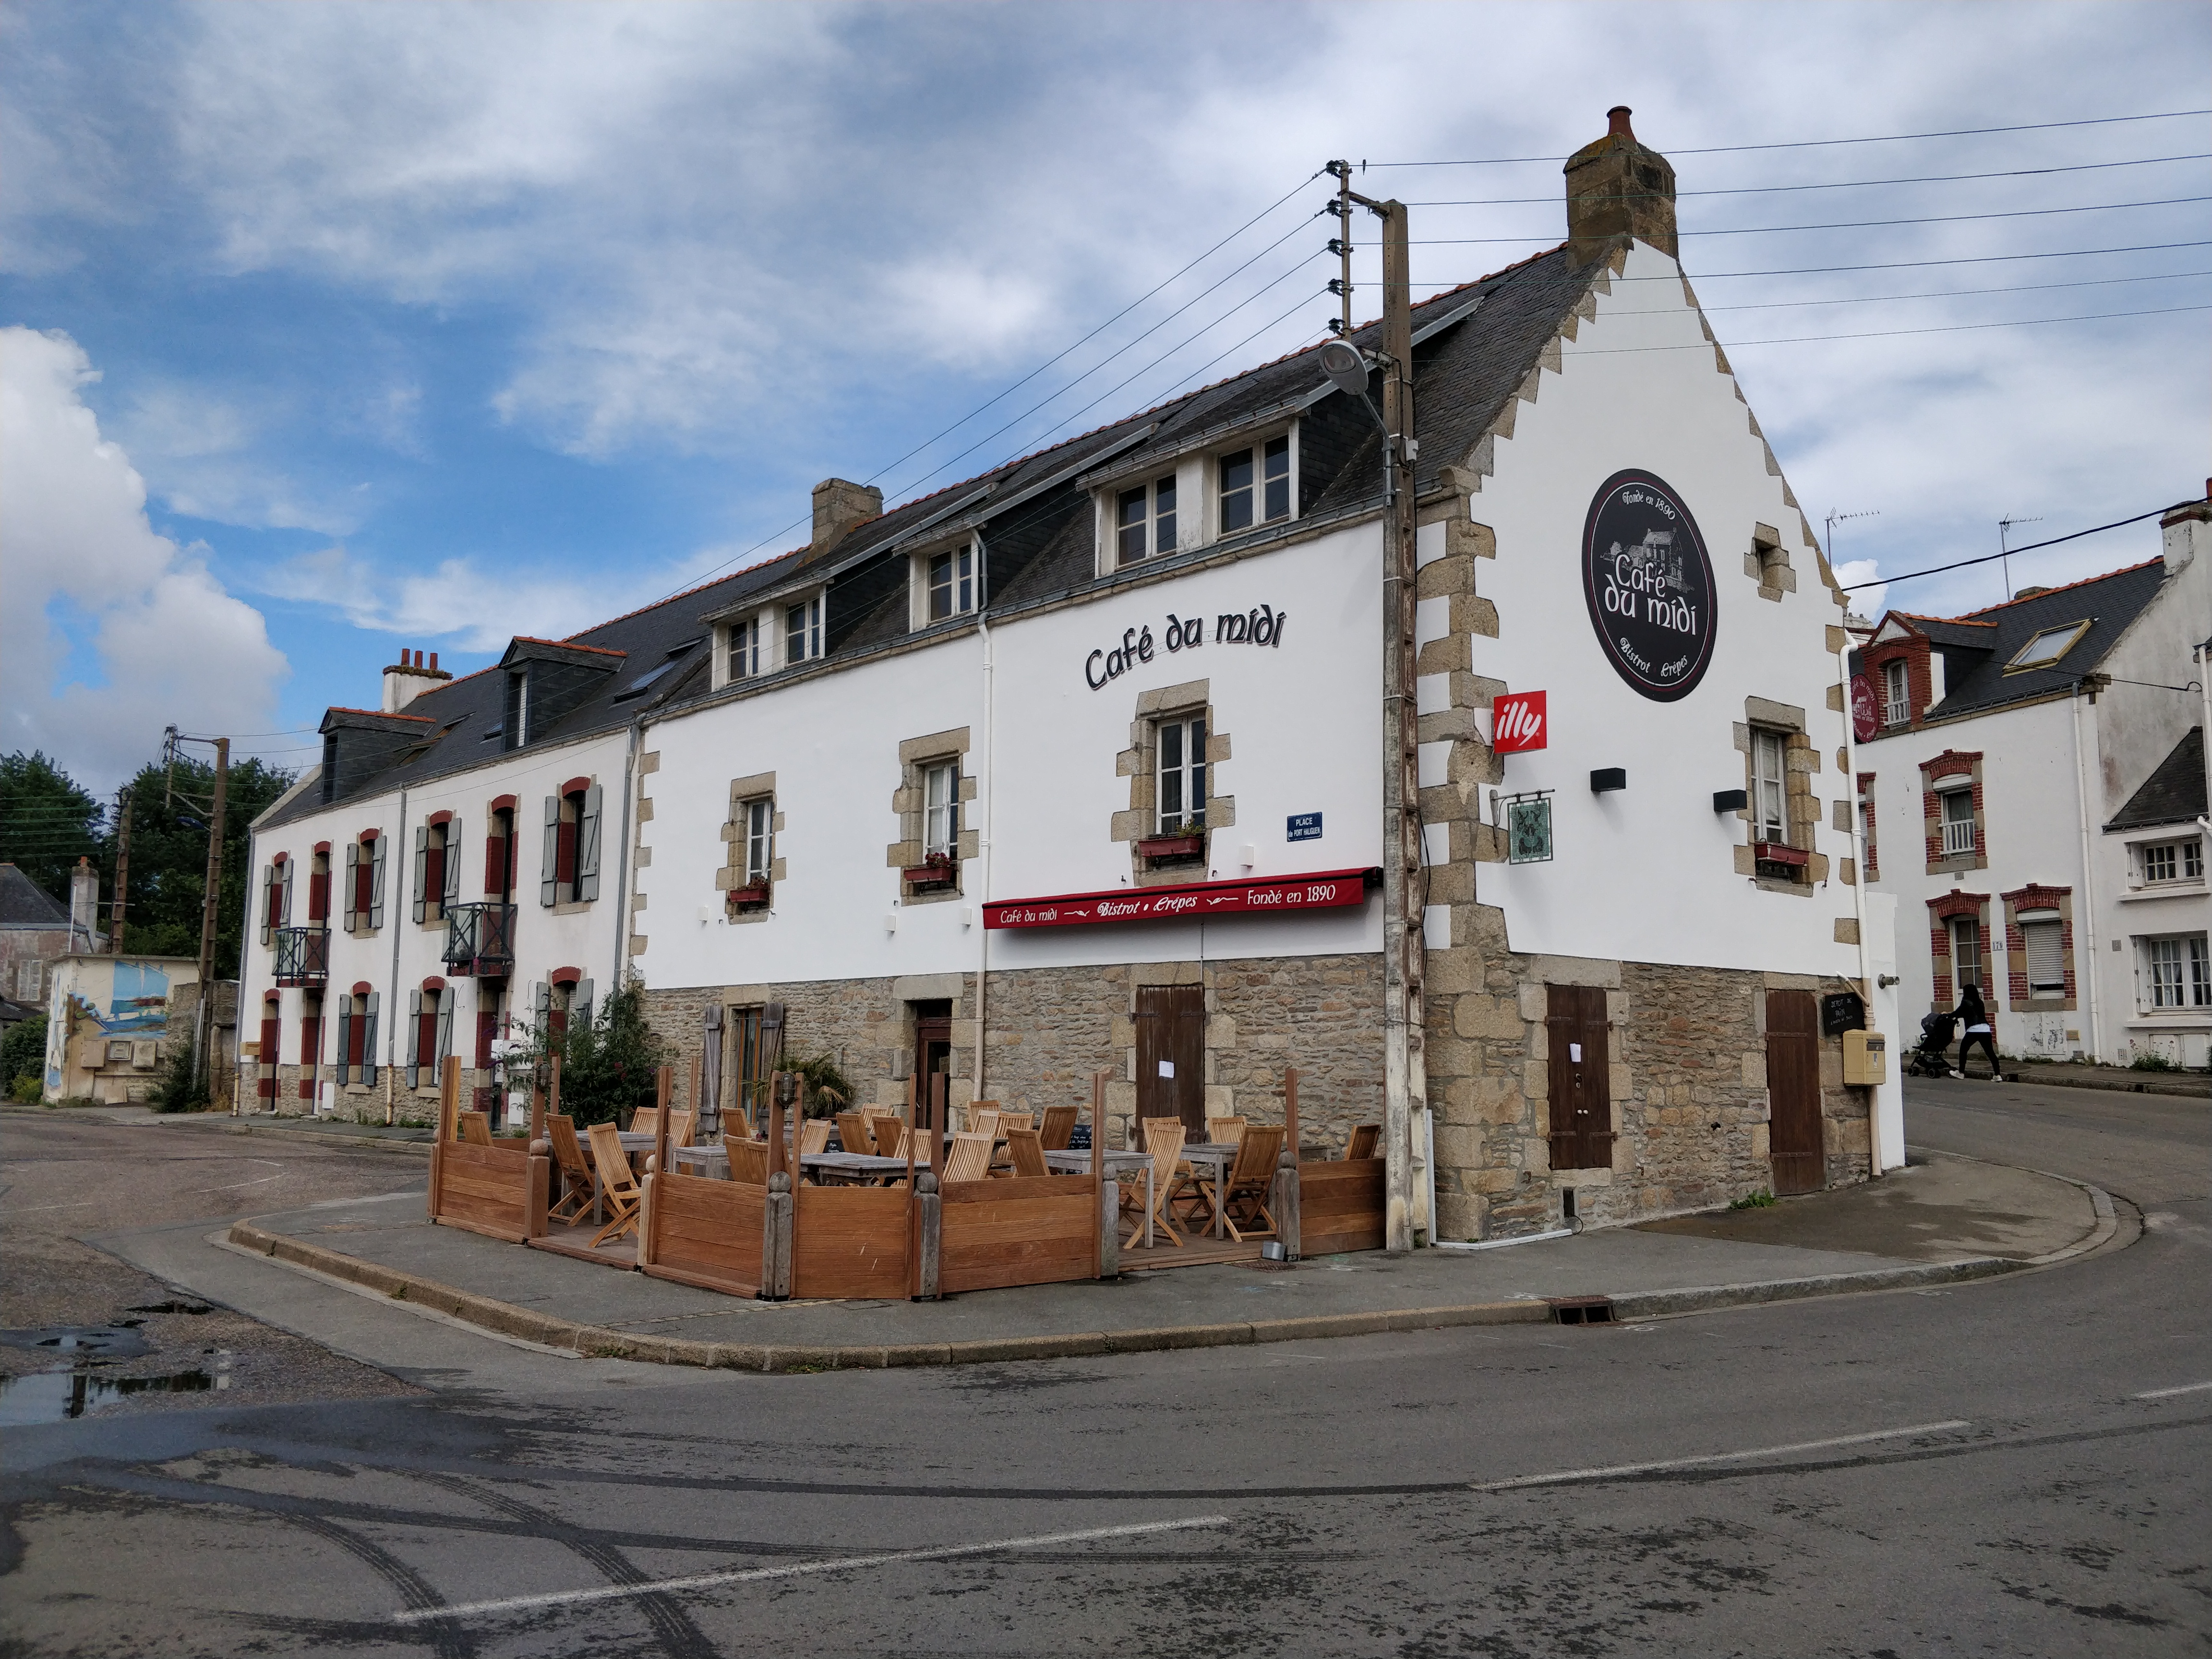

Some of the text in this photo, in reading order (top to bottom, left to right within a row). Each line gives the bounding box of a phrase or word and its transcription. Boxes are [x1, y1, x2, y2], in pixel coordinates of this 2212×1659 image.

[1623, 489, 1675, 520] Fondé en 1890
[1615, 554, 1666, 598] Café
[1605, 574, 1696, 636] du midi
[1085, 604, 1286, 690] Café du midi
[1621, 637, 1650, 673] Bistrot
[1860, 679, 1865, 687] du
[1865, 685, 1875, 701] midi
[1496, 701, 1541, 746] illy
[1294, 829, 1303, 837] PORT
[1303, 827, 1321, 836] HALIGUEN
[1296, 817, 1313, 827] PLACE
[1001, 910, 1021, 924] Café
[1024, 909, 1036, 921] du
[1038, 908, 1058, 921] midi
[1097, 901, 1141, 917] Bistrot
[1248, 890, 1282, 905] Fondé
[1286, 891, 1301, 903] en
[1306, 884, 1336, 902] 1890
